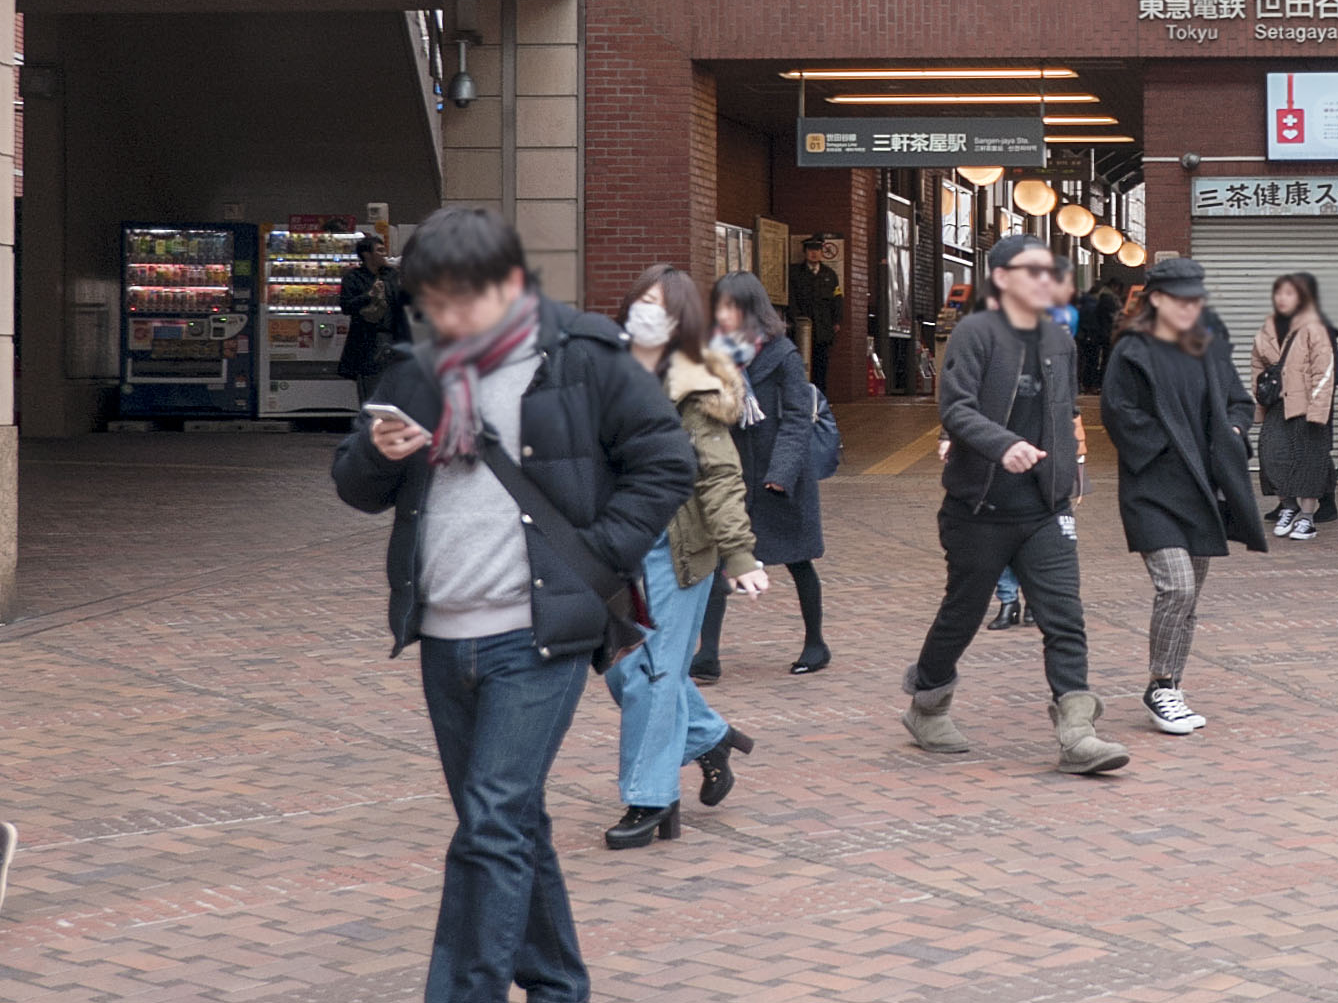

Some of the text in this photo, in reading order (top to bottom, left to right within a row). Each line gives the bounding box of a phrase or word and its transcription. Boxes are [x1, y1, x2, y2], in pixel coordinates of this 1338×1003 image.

[1166, 24, 1219, 43] Tokyu
[1255, 23, 1338, 43] Setagaya
[872, 133, 967, 152] 三軒茶屋駅
